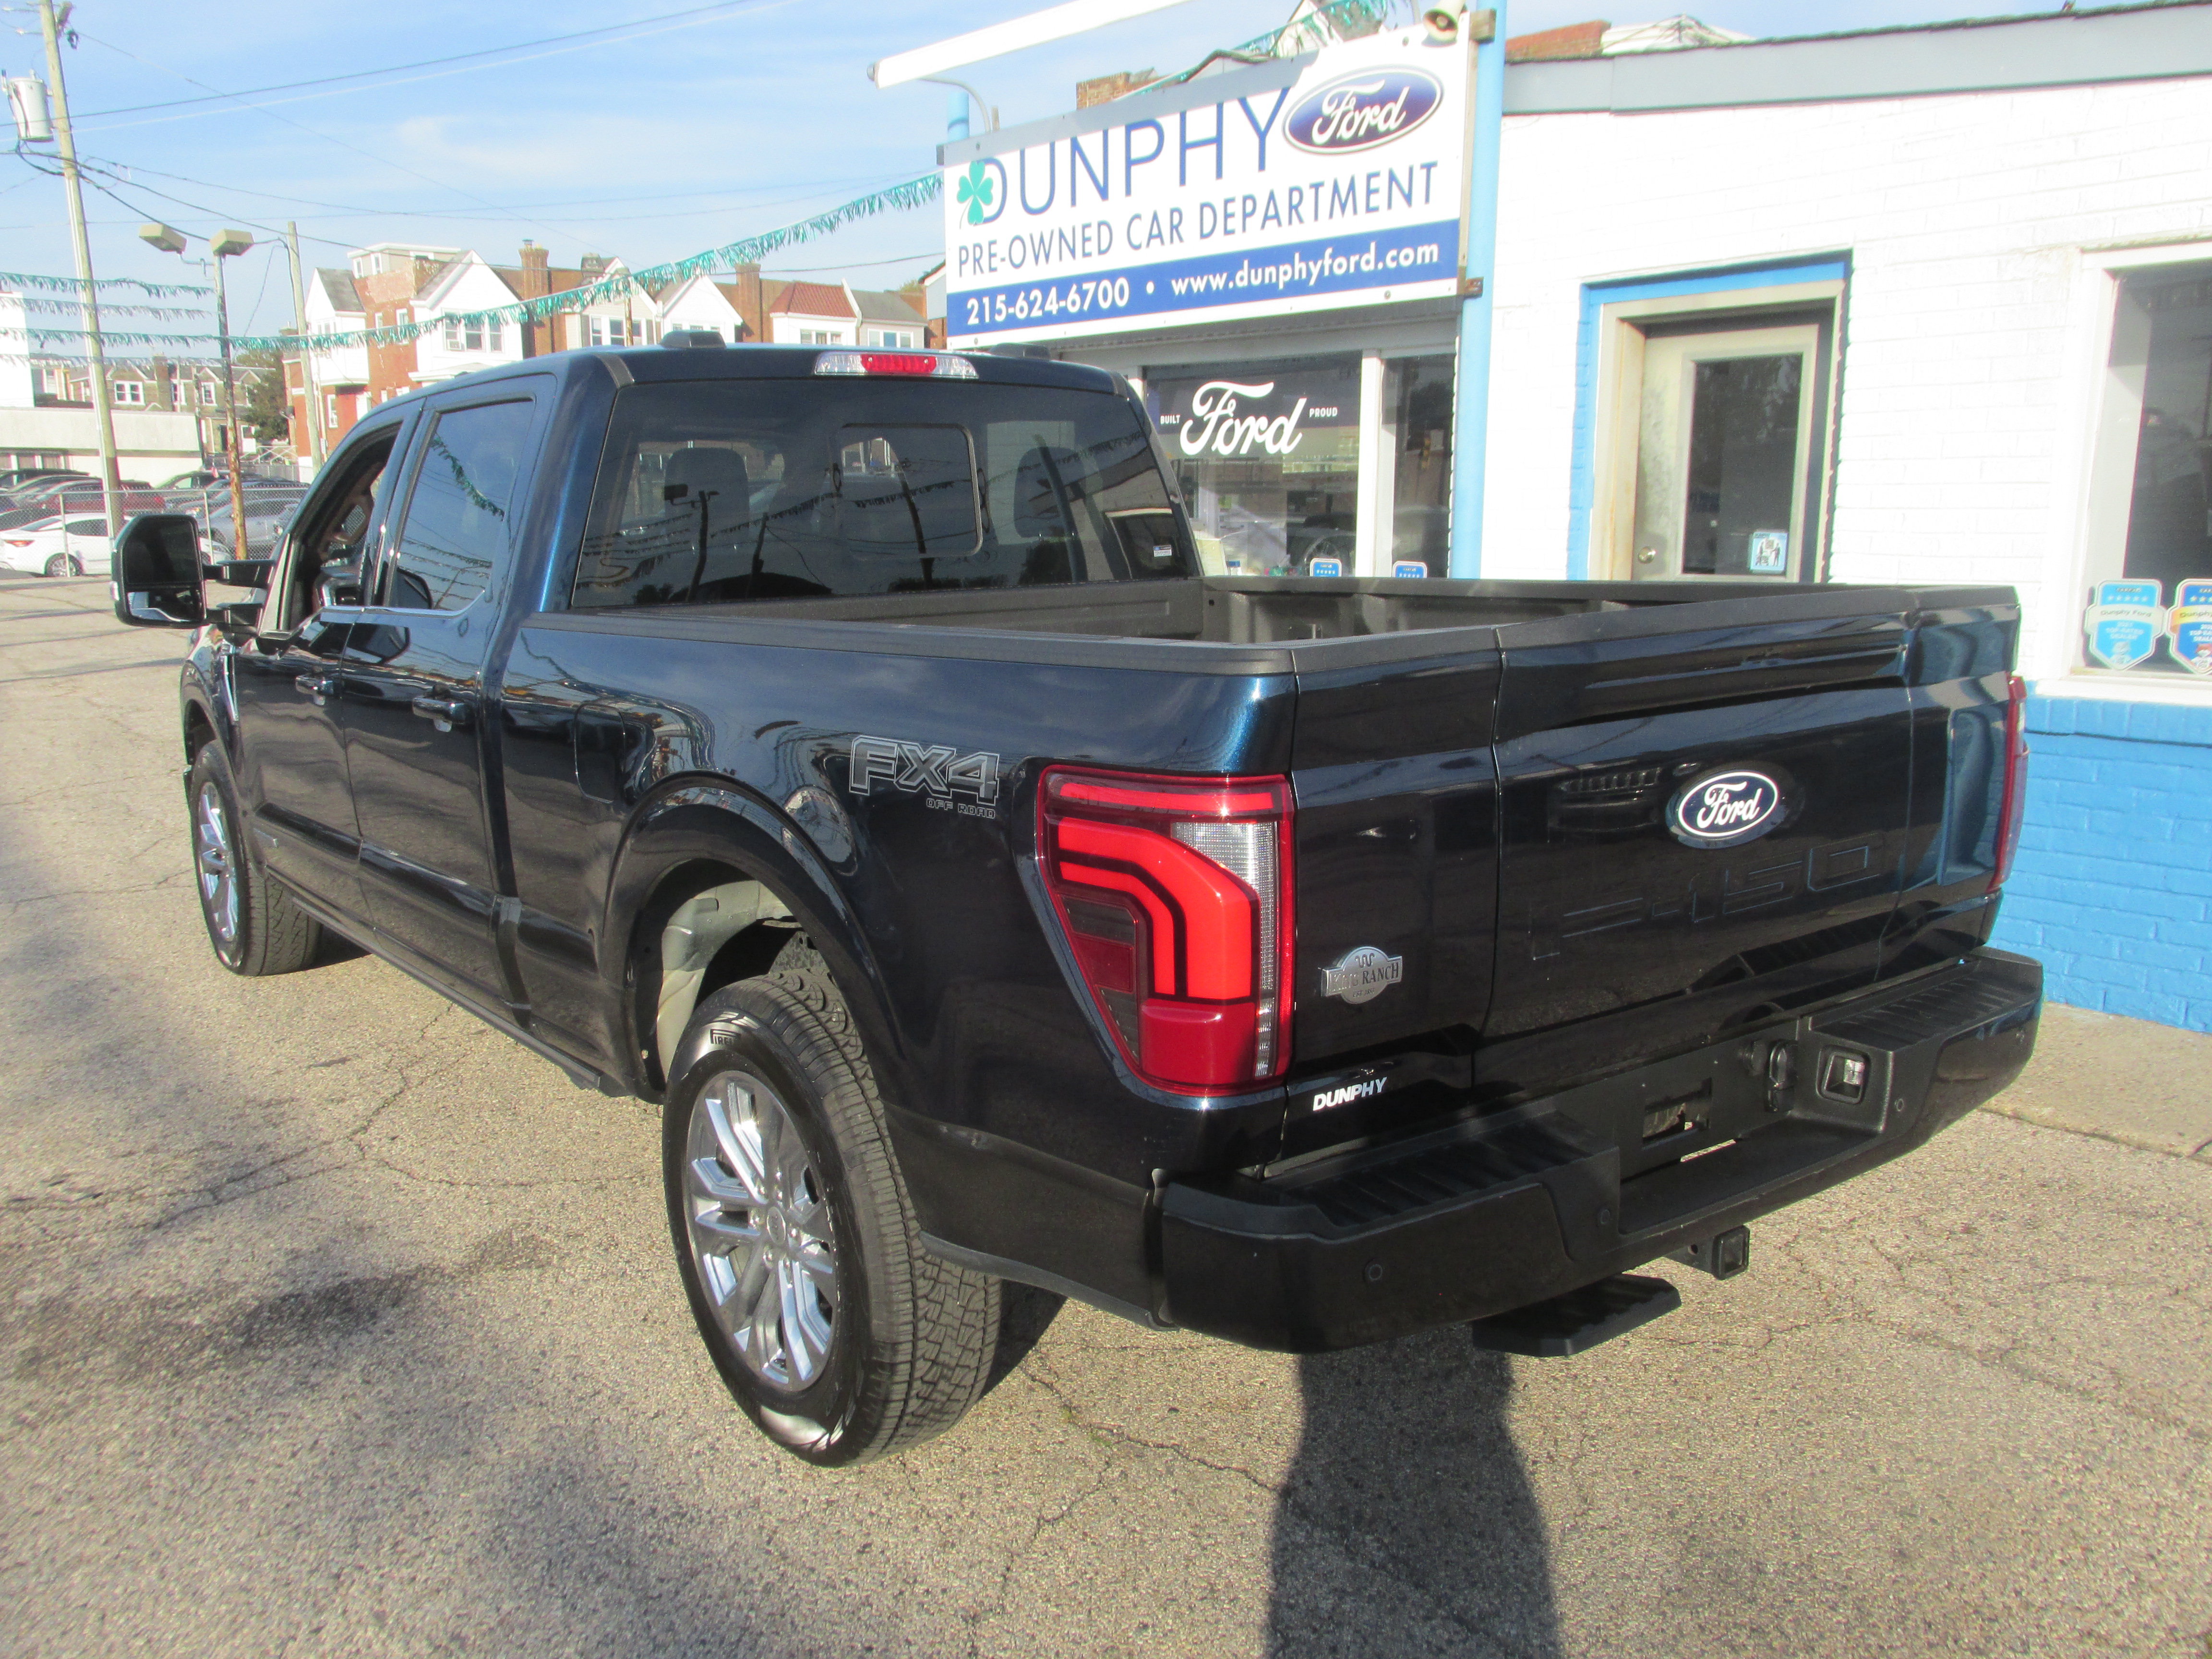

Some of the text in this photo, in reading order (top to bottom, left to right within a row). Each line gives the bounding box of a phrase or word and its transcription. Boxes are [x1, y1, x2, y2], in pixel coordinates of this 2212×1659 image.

[1311, 79, 1409, 145] Ford
[972, 85, 1291, 226] DUNPHY
[959, 160, 1438, 277] PRE-OWNED CAR DEPARTMENT
[966, 241, 1439, 325] 215-624-6700 www.dunphyford.com
[1160, 381, 1338, 456] BUILT Ford PROUD
[849, 735, 1000, 806] FX4
[926, 797, 996, 819] OFF ROAD
[1695, 781, 1763, 829] Ford
[1363, 961, 1399, 985] RANCH
[710, 1029, 741, 1046] PIREL
[1312, 1077, 1387, 1112] DUNPHY
